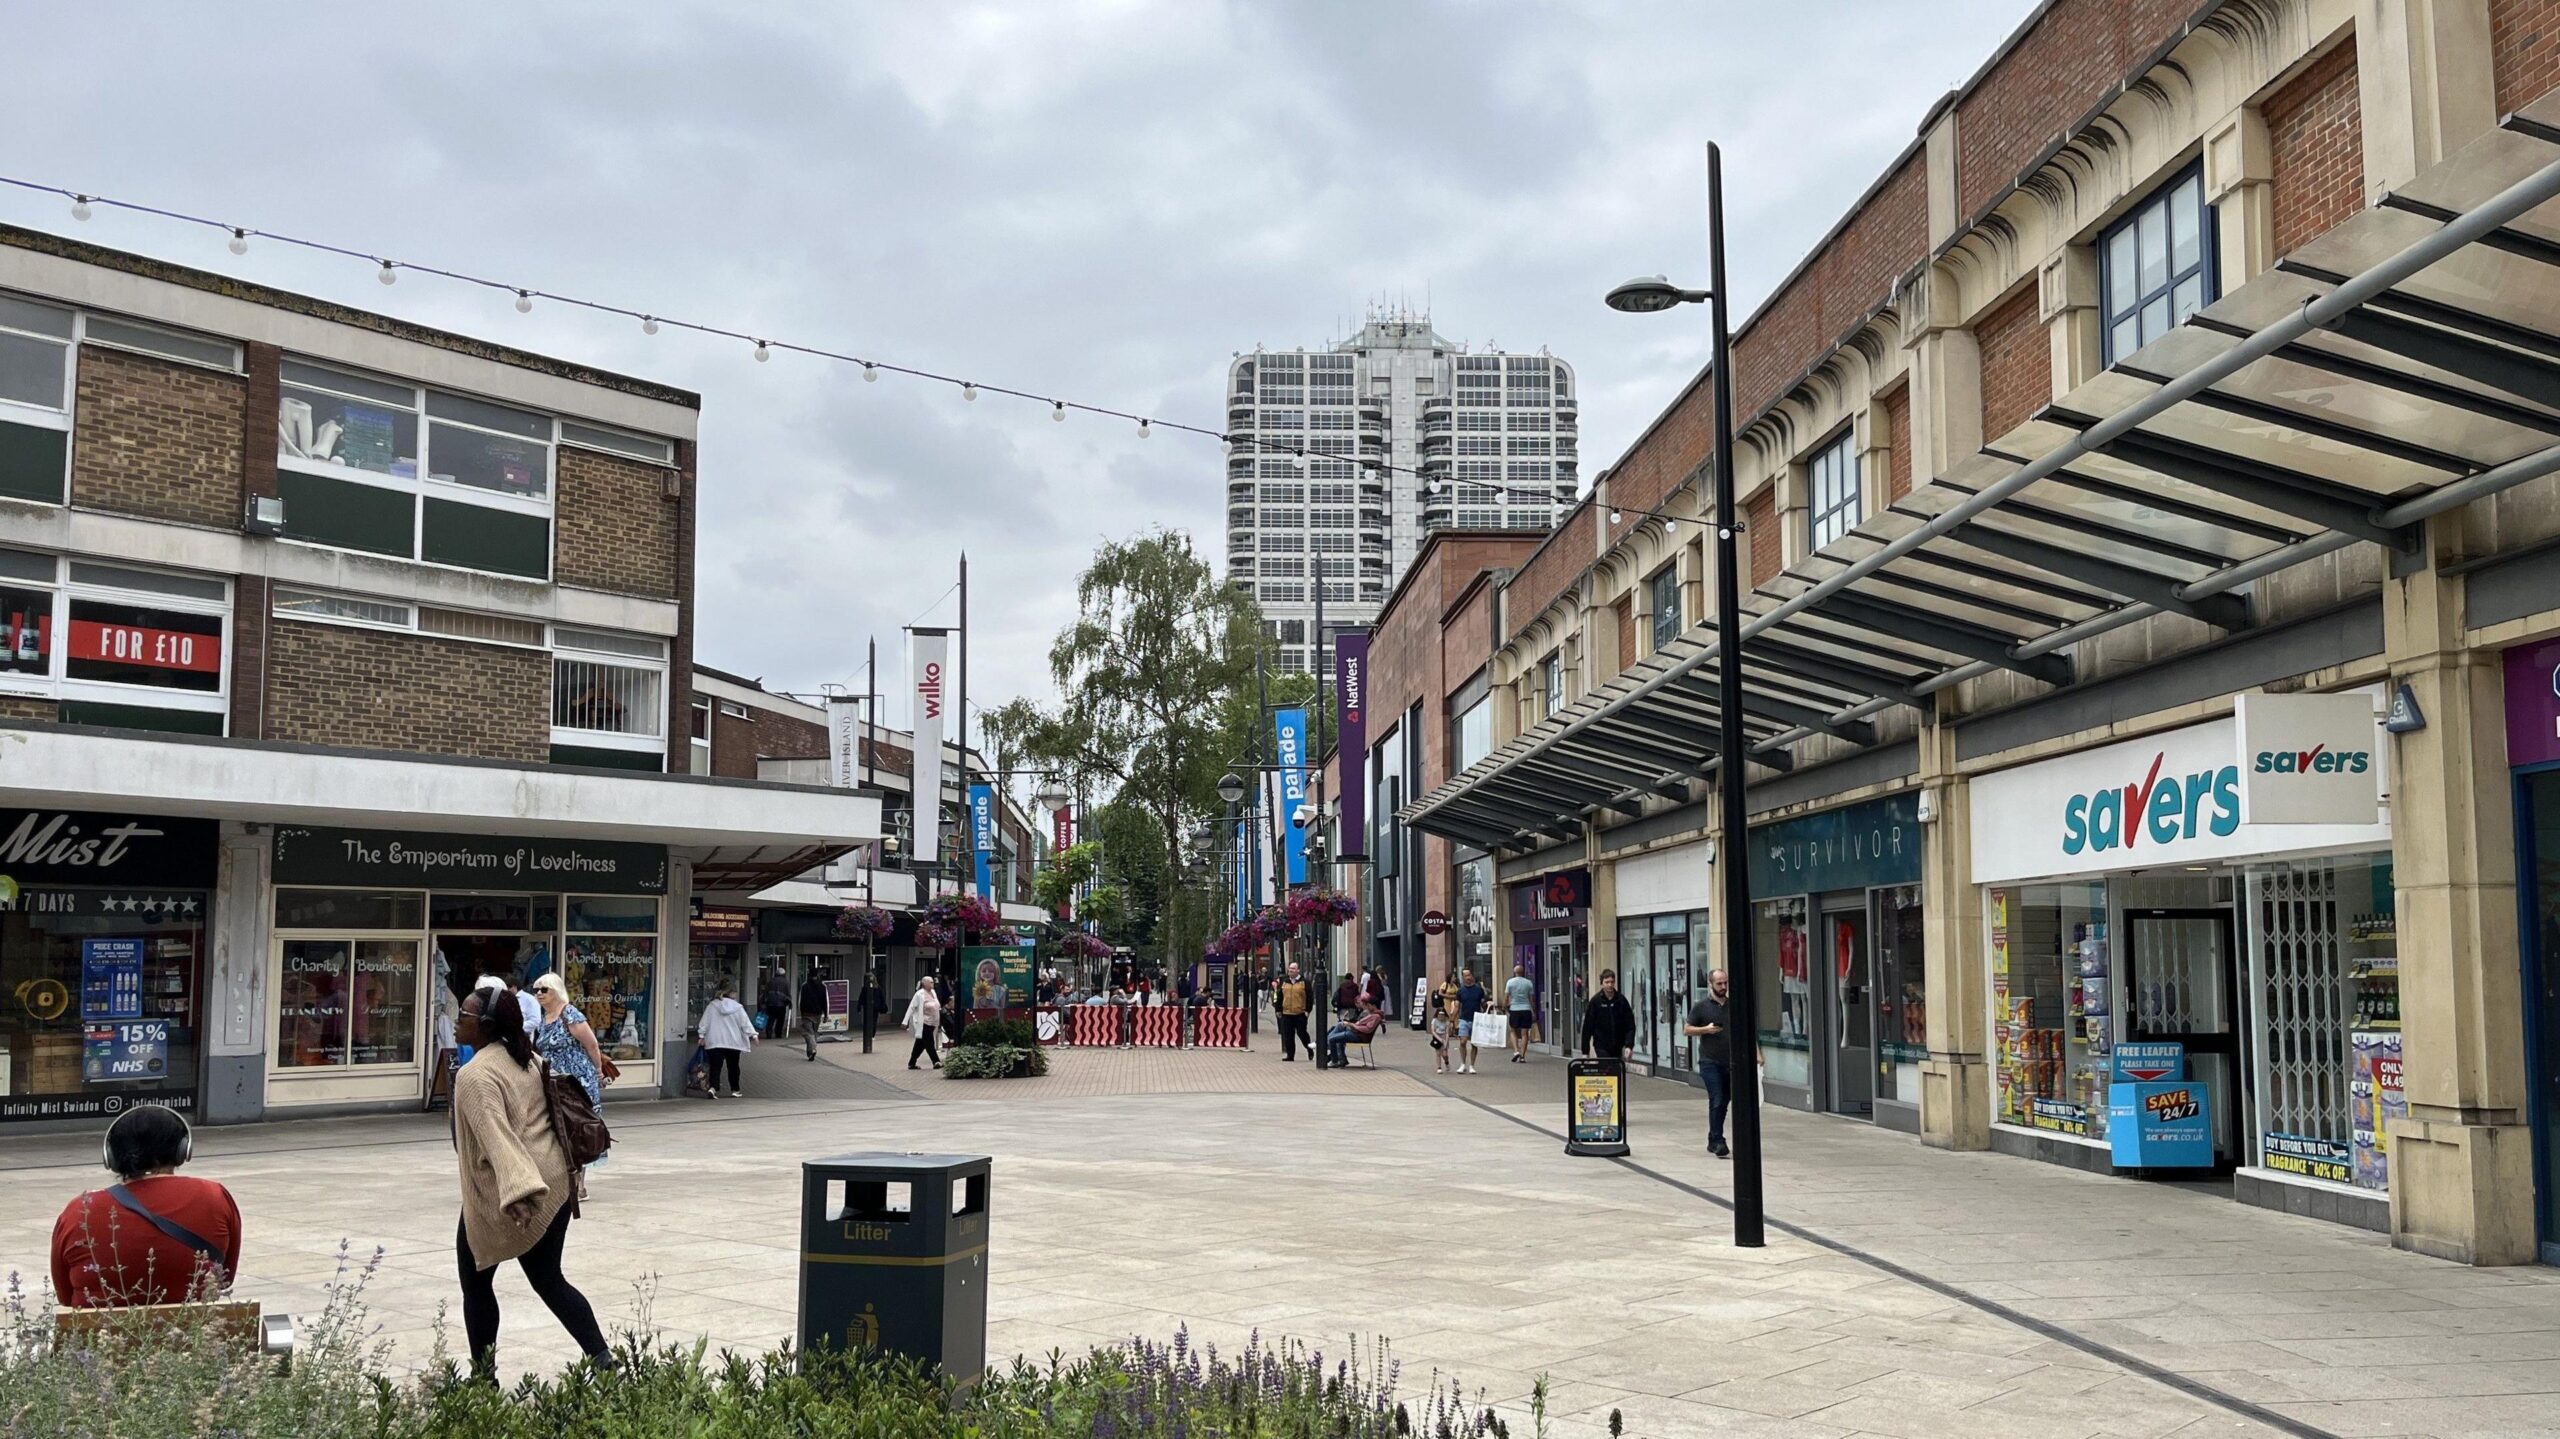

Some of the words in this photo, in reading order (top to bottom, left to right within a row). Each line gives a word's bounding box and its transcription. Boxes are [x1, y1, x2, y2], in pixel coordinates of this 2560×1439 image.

[101, 628, 143, 660] FOR
[155, 634, 193, 665] £10
[918, 662, 940, 719] wilko
[1346, 657, 1359, 708] NatWest
[842, 716, 851, 756] ISLAND
[2254, 743, 2369, 773] savers
[842, 761, 851, 788] IVER
[2062, 752, 2240, 855] savers
[975, 796, 990, 850] parade
[0, 813, 164, 867] Mist
[1780, 826, 1902, 872] SURVIVOR
[341, 839, 381, 864] The
[388, 842, 498, 872] Emporium
[504, 850, 525, 876] of
[530, 848, 616, 874] Loveliness
[24, 893, 31, 911] 7
[38, 893, 75, 912] DAYS
[291, 957, 340, 977] Charity
[356, 954, 413, 977] Boutique
[565, 950, 604, 968] Charity
[606, 949, 654, 967] Boutique
[120, 1024, 167, 1042] 15%
[128, 1043, 154, 1054] OFF
[2116, 1046, 2140, 1056] FREE
[2142, 1046, 2180, 1056] LEAFLET
[112, 1060, 144, 1072] NHS
[2120, 1060, 2142, 1068] PLEASE
[2144, 1060, 2160, 1068] TAKE
[2161, 1060, 2174, 1068] ONE
[4, 1102, 37, 1115] Infinity
[41, 1101, 60, 1114] Mist
[64, 1099, 99, 1112] Swindon
[2149, 1091, 2187, 1109] SAVE
[2162, 1103, 2196, 1120] 24/7
[2266, 1136, 2278, 1149] BUY
[2280, 1139, 2301, 1153] BEFORE
[2302, 1141, 2316, 1154] YOU
[2317, 1143, 2328, 1155] FLY
[2266, 1153, 2307, 1174] FRAGRANCE
[2314, 1162, 2330, 1178] 60%
[2332, 1165, 2346, 1180] OFF
[844, 1223, 892, 1241] Litter
[960, 1219, 978, 1235] Litter
